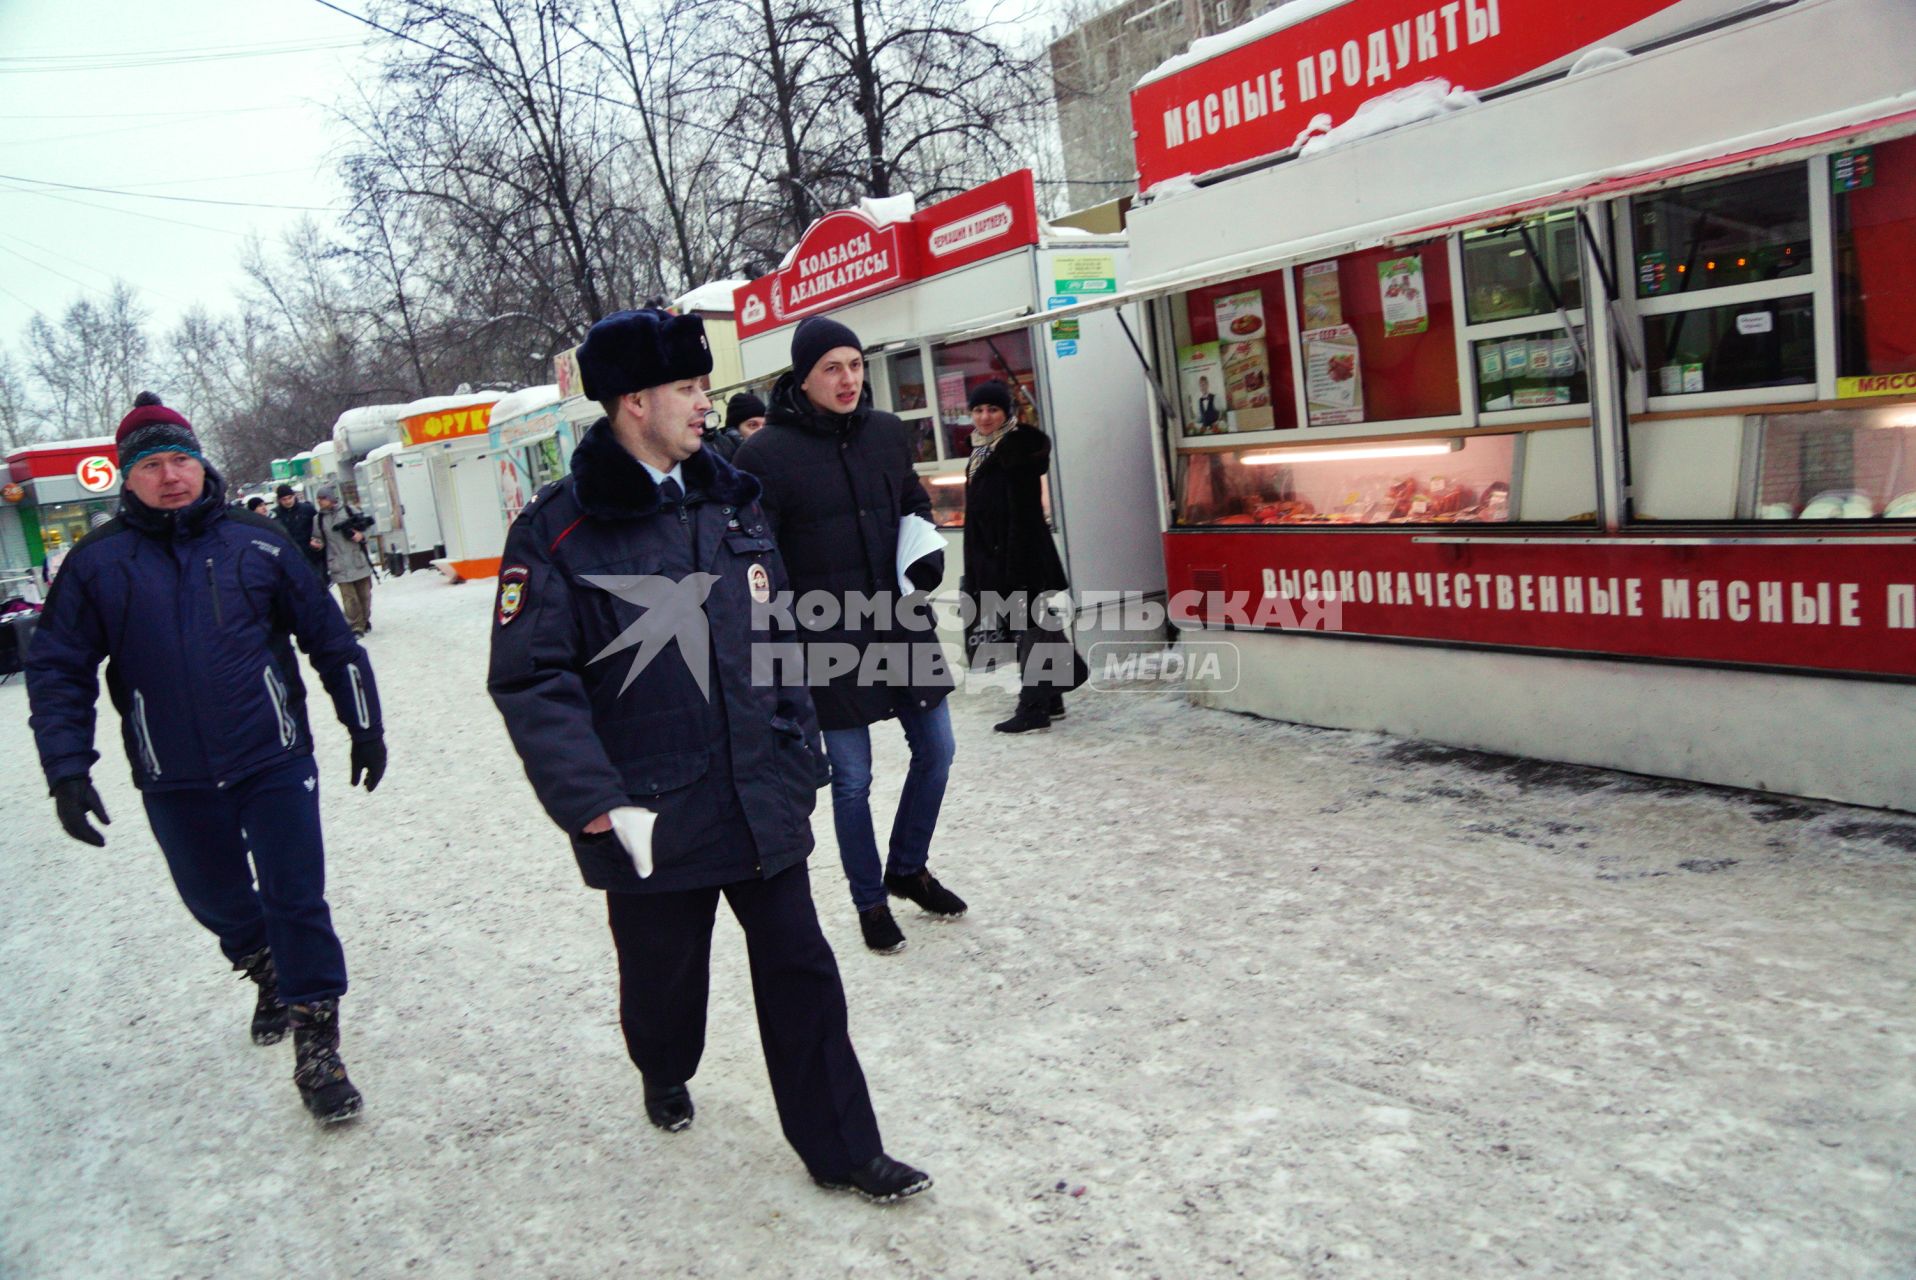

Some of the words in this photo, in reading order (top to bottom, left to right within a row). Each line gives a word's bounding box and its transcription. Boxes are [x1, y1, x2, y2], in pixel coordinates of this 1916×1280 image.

[1163, 68, 1287, 149] МЯСНЫЕ
[1297, 0, 1501, 103] ПРОДУКТЫ
[789, 249, 889, 306] ДЕЛИКАТЕСЫ
[799, 232, 872, 278] КОЛБАСЫ
[1262, 568, 1643, 616] ВЫСОКОКАЧЕСТВЕННЫЕ
[1661, 579, 1861, 626] МЯСНЫЕ
